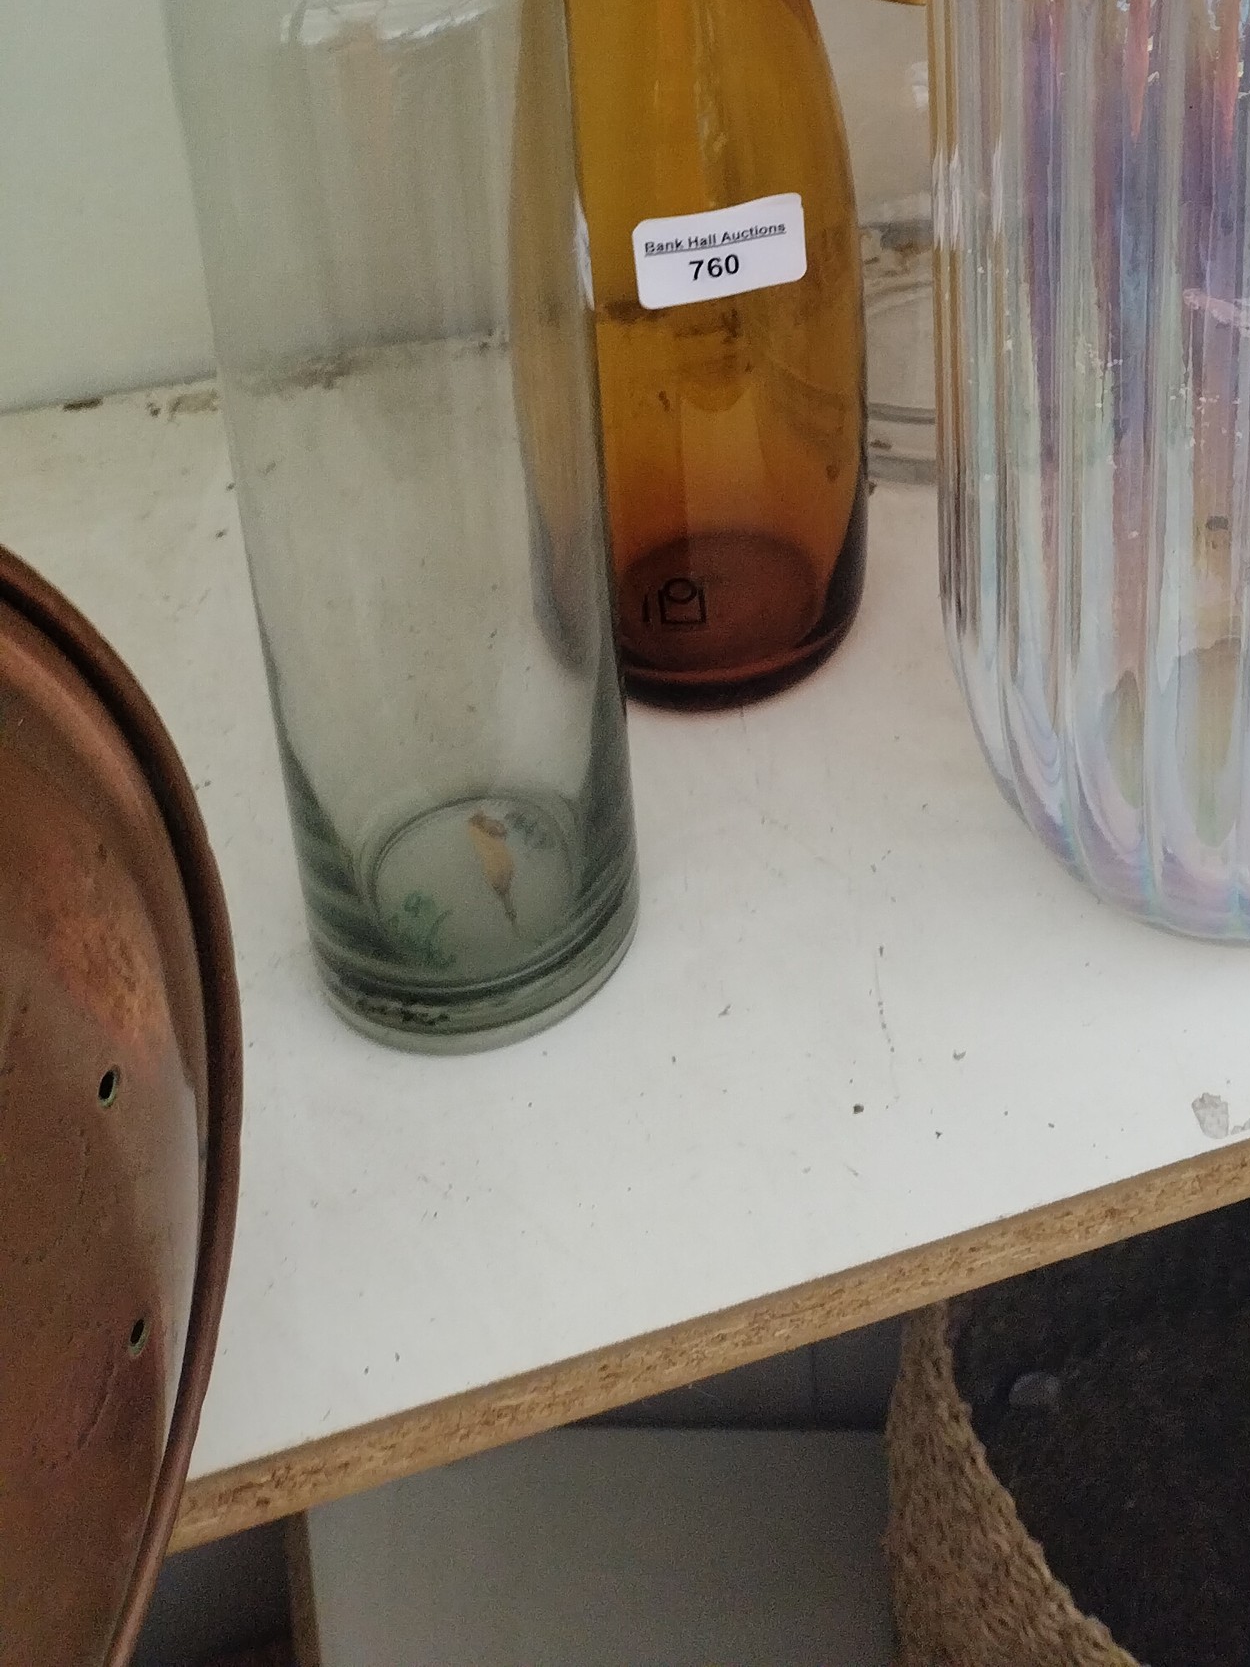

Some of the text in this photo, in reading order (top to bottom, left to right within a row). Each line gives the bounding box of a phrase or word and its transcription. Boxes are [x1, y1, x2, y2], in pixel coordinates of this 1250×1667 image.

[645, 222, 786, 254] Bank Hall Auctions
[689, 254, 740, 281] 760
